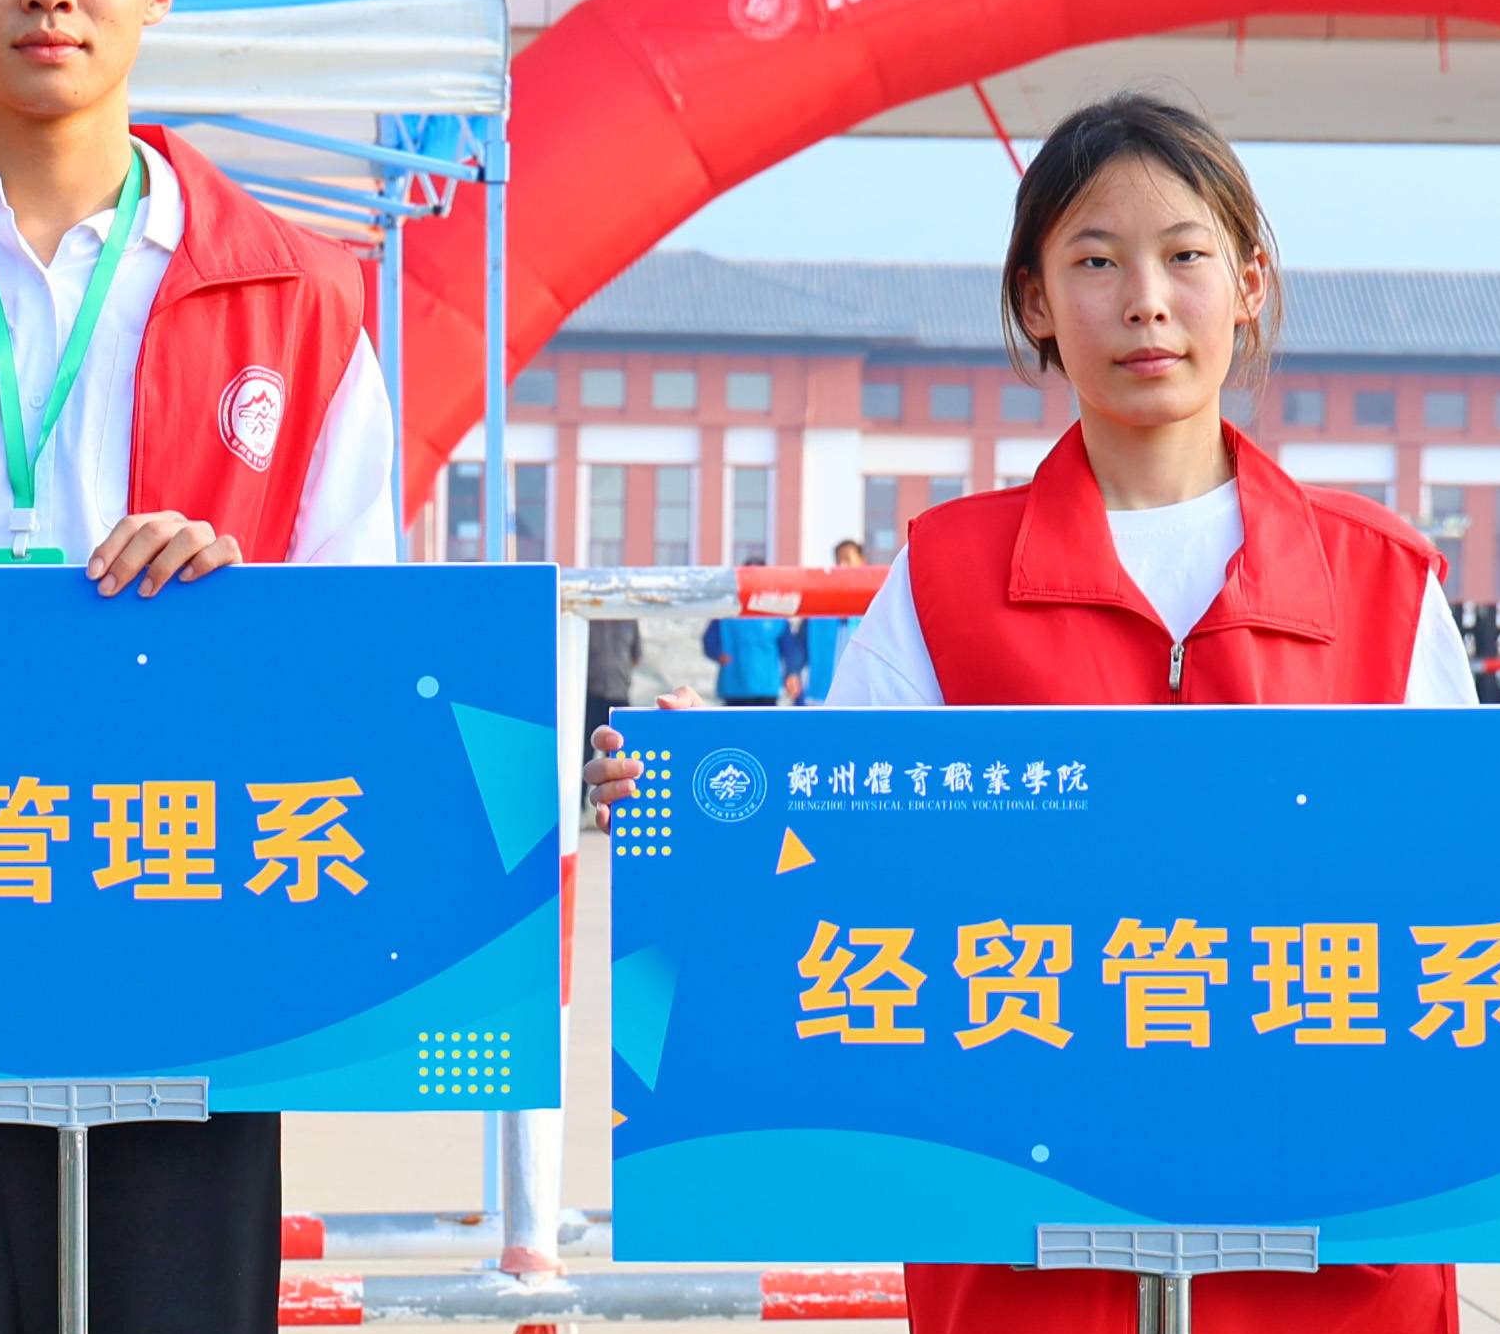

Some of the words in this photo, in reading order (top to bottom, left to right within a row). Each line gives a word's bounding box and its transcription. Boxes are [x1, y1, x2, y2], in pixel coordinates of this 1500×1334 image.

[787, 760, 1089, 798] 鄭州體育職業學院
[787, 800, 847, 811] ZHENGZHOU
[851, 800, 903, 811] PHYSICAL
[908, 800, 968, 811] EDUCATION
[972, 800, 1038, 811] VOCATIONAL
[1042, 800, 1089, 811] COLLEGE
